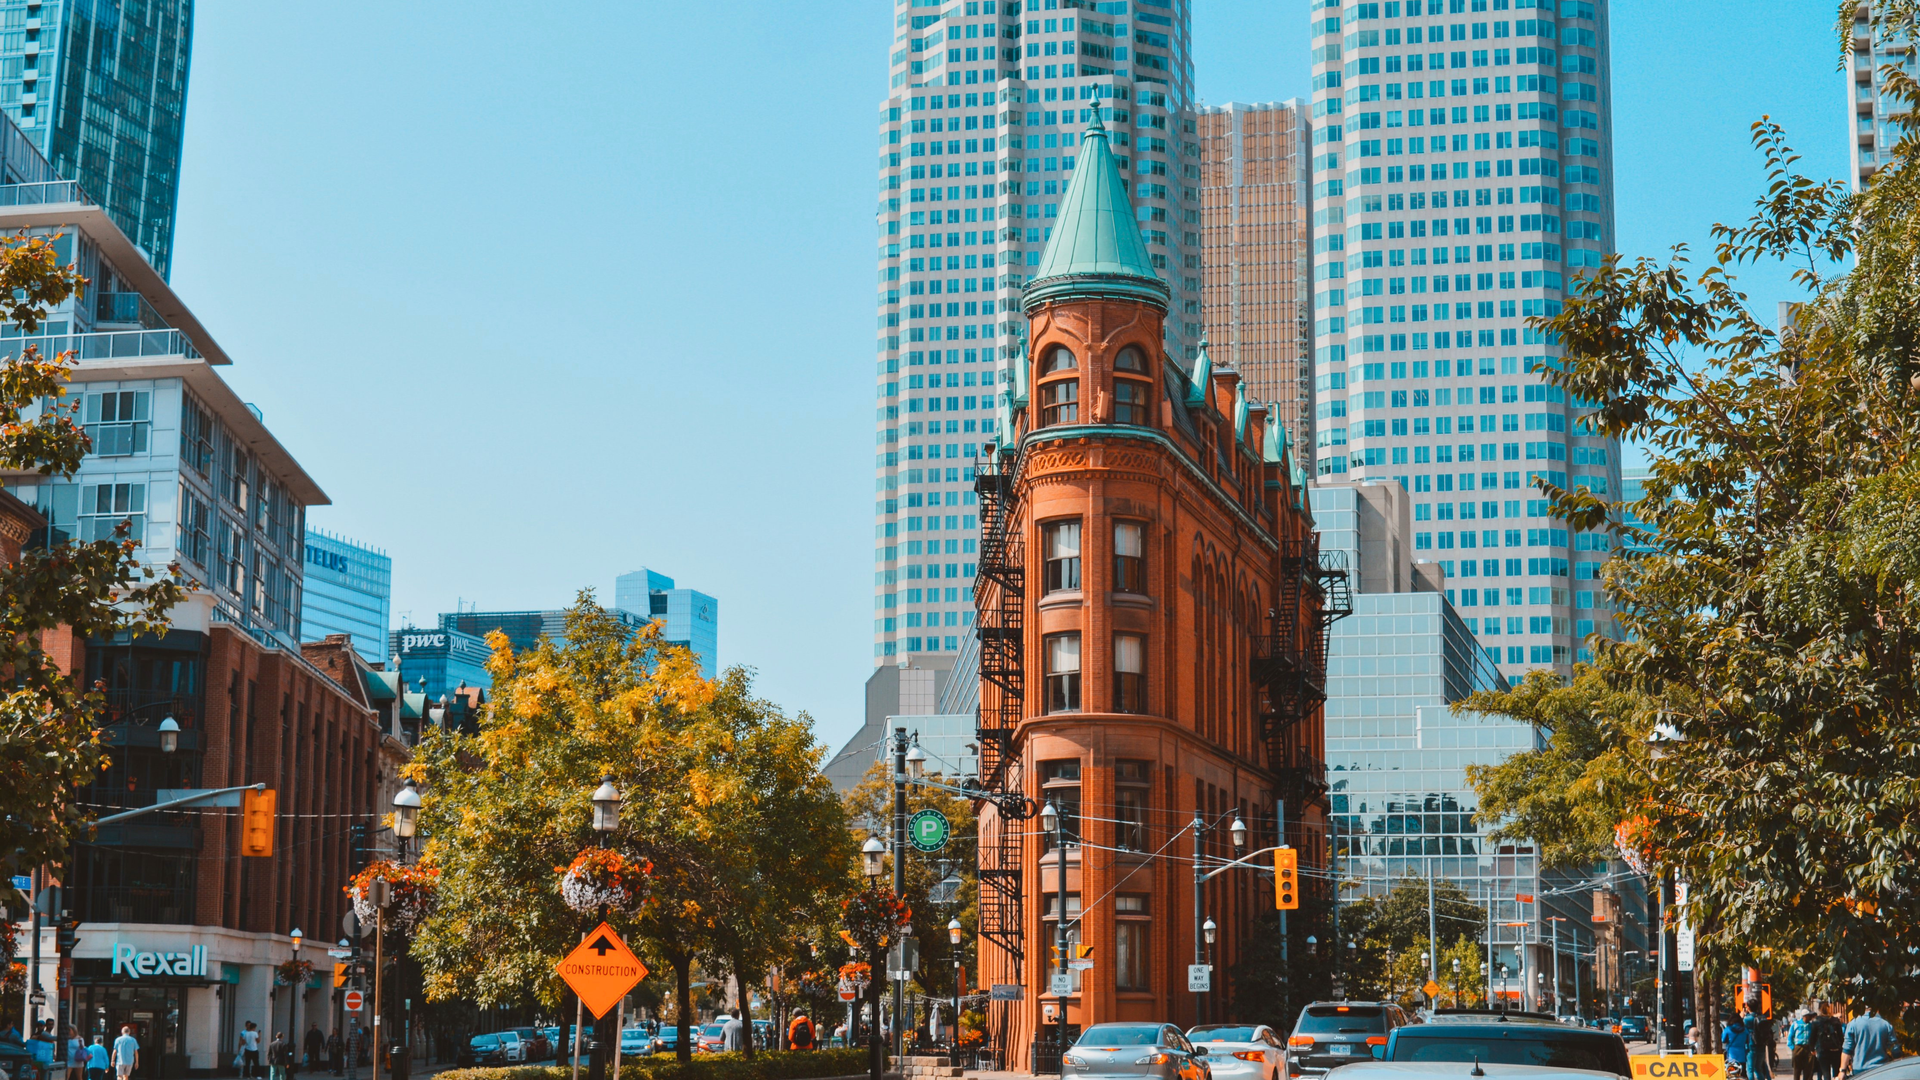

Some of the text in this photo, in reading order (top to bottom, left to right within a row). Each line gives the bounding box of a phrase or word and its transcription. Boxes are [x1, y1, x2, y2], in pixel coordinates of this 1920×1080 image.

[305, 544, 348, 573] TELUS
[402, 633, 446, 653] pwc
[450, 636, 469, 652] pwc
[921, 820, 938, 837] P
[112, 942, 208, 979] Rexall
[565, 963, 638, 978] CONSTRUCTION
[1193, 966, 1204, 974] ONE
[1058, 976, 1067, 984] NO
[1189, 982, 1209, 990] BEGINS
[1649, 1061, 1699, 1078] CAR
